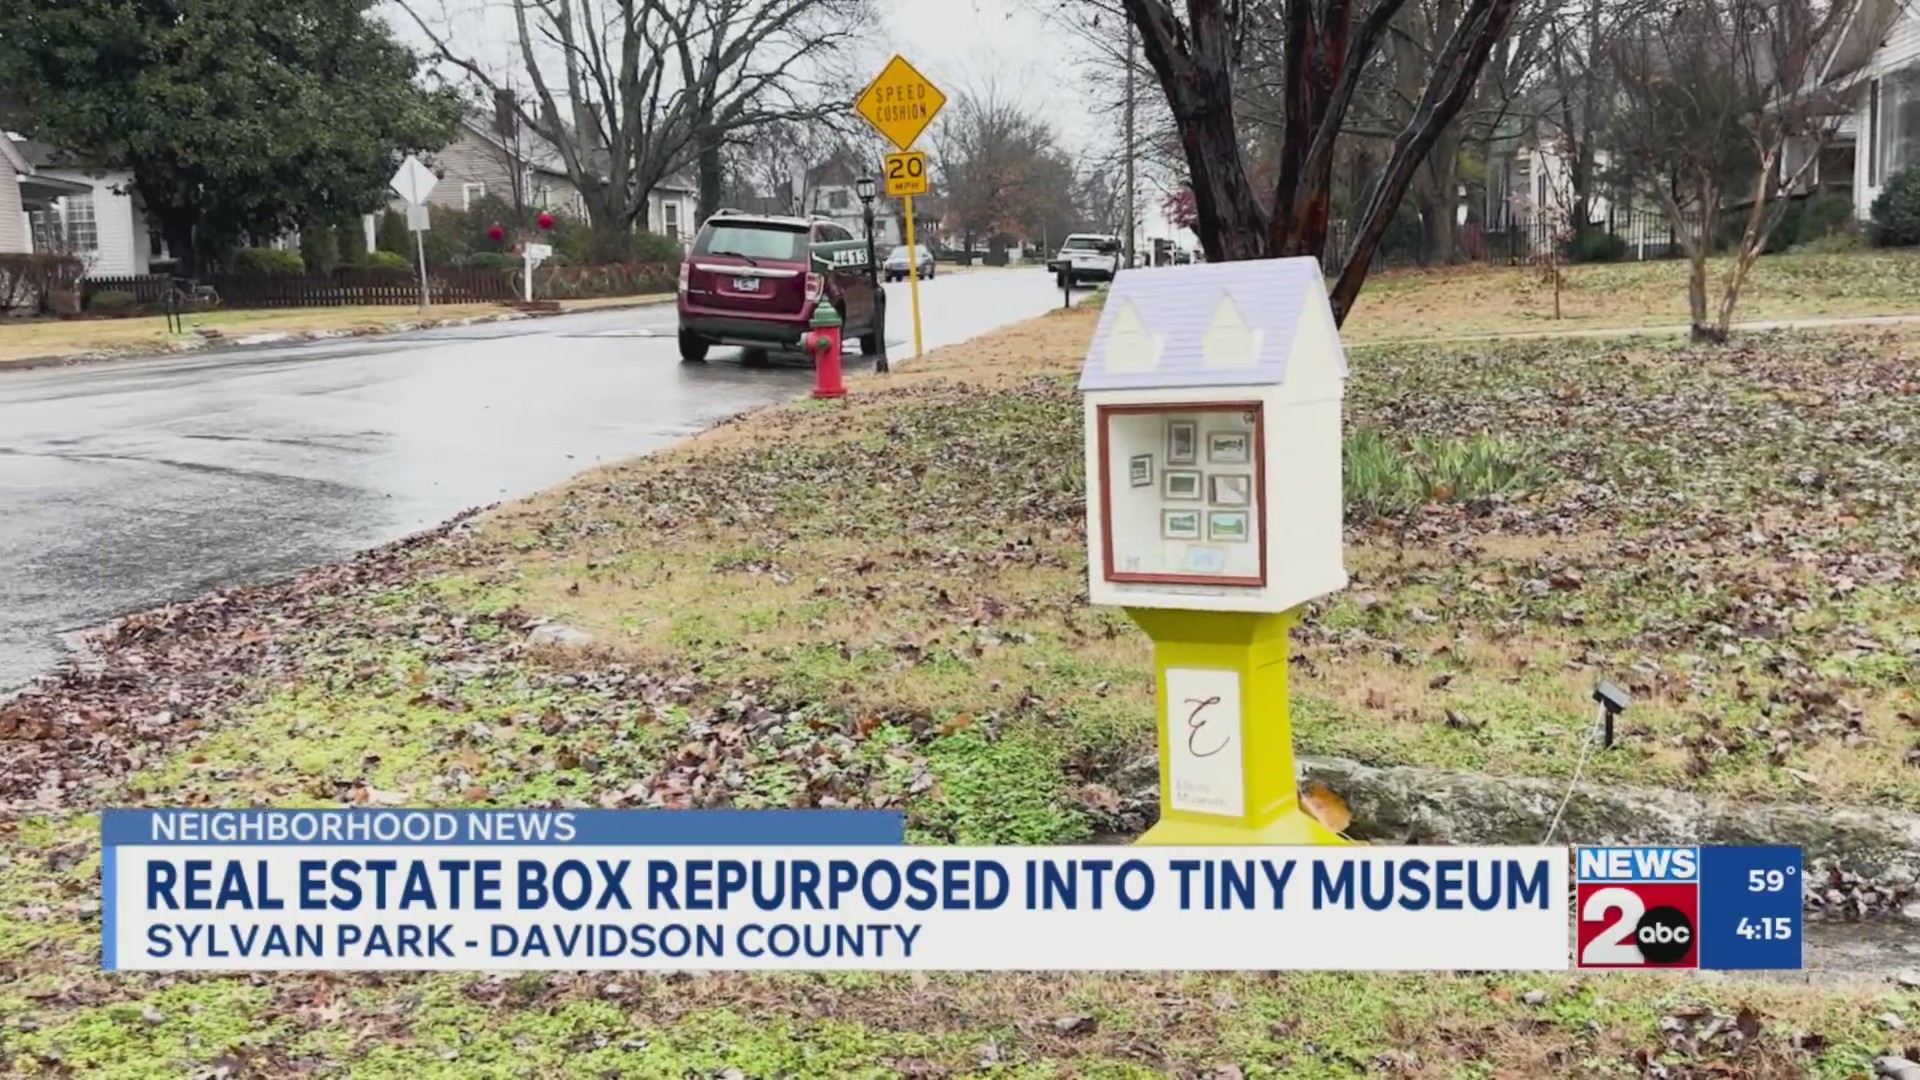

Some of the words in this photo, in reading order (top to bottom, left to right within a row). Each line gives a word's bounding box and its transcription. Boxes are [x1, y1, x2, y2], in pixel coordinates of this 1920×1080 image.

[875, 84, 925, 102] SPEED
[876, 103, 927, 122] CUSHION
[889, 157, 922, 179] 20
[895, 182, 919, 191] MPH
[833, 249, 867, 265] 4413
